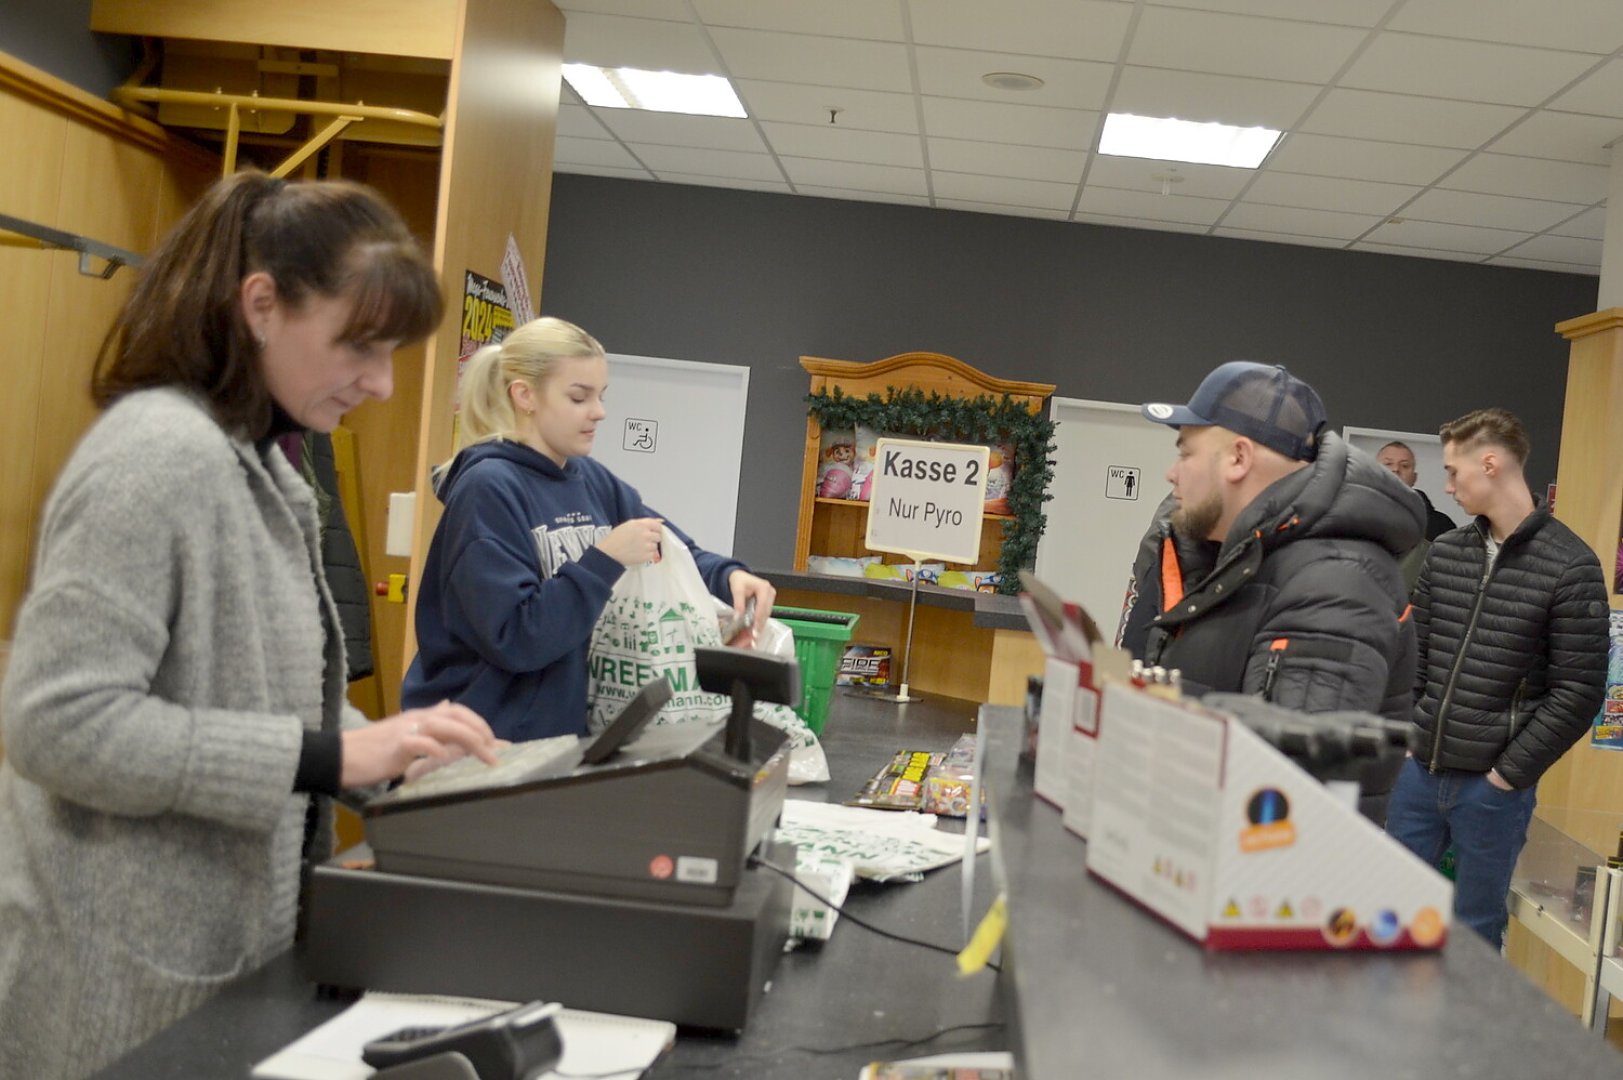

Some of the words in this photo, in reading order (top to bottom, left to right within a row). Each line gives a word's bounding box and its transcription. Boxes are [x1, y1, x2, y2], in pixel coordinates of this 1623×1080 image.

[463, 295, 493, 342] 2024
[628, 421, 642, 431] WC
[884, 451, 957, 483] Kasse
[964, 460, 979, 486] 2
[1110, 469, 1125, 479] WC
[889, 497, 919, 520] Nur
[923, 502, 962, 528] Pyro
